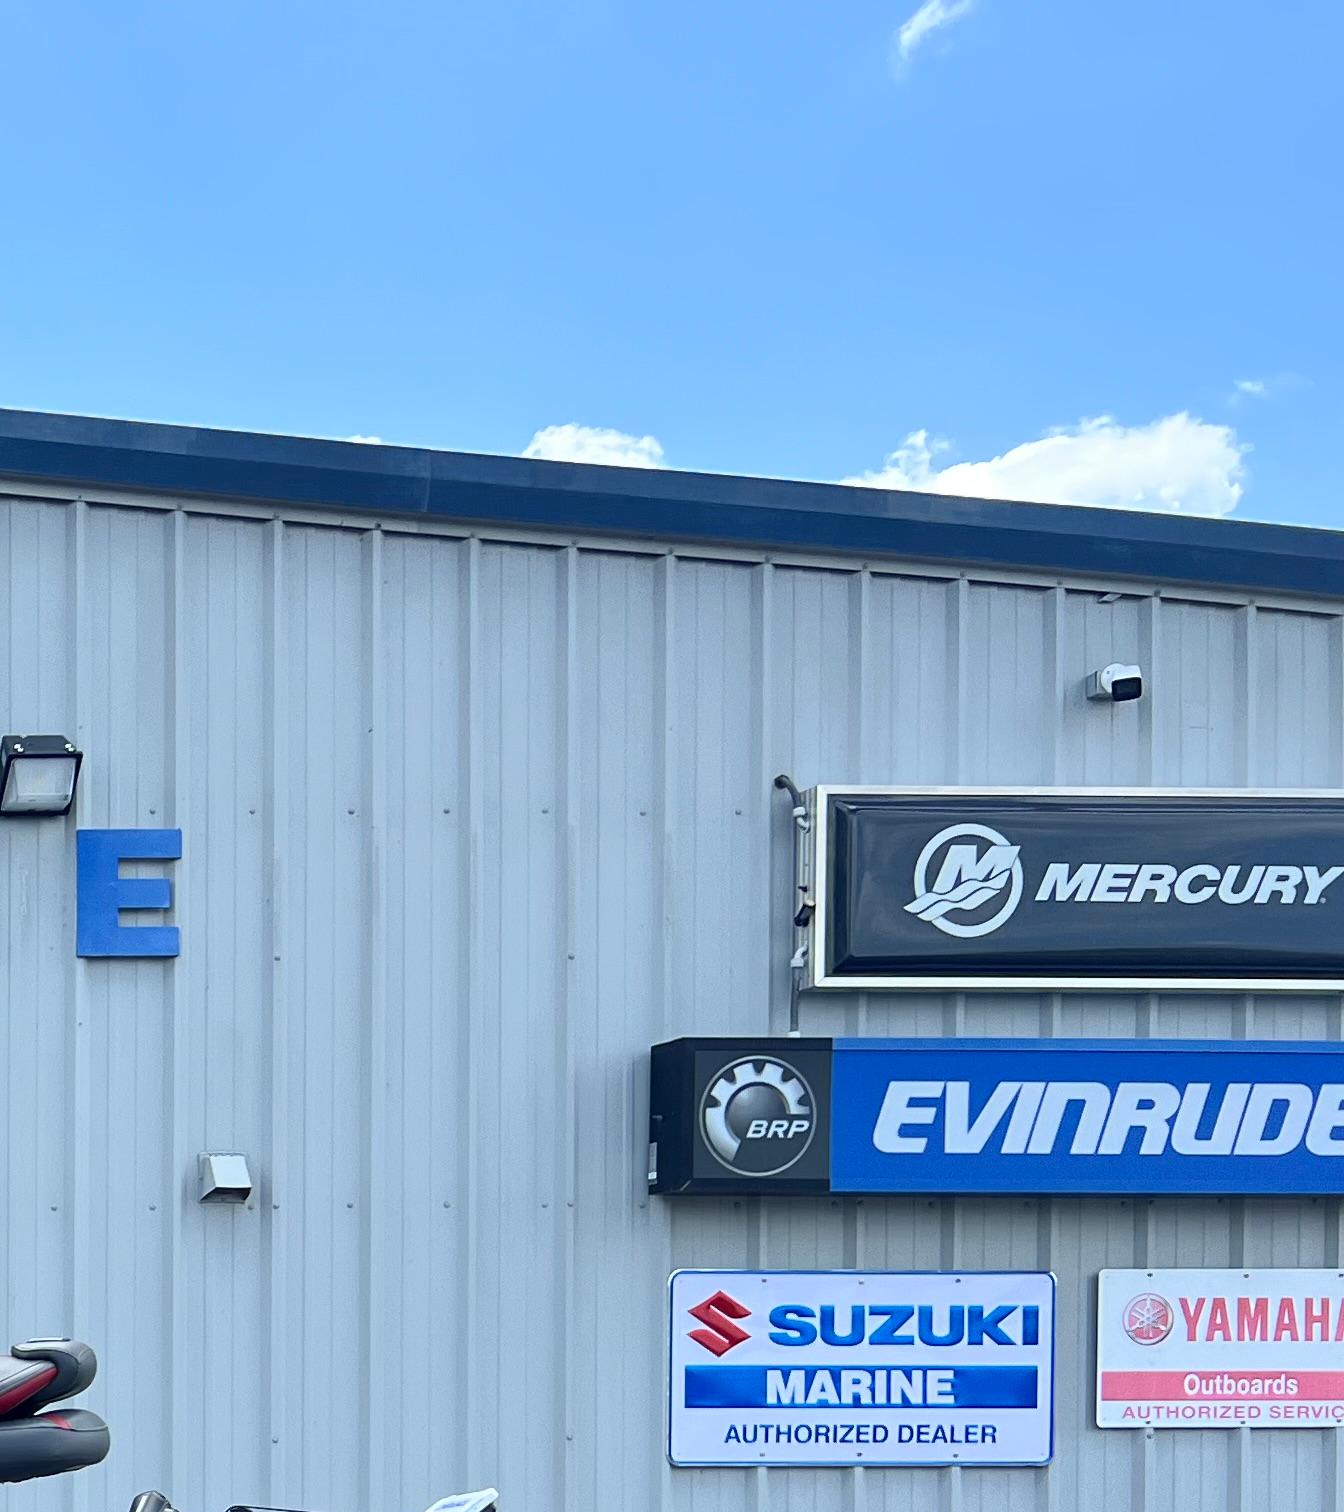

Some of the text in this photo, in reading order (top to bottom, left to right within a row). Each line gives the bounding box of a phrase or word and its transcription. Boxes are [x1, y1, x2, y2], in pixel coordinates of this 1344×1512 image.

[1035, 863, 1344, 904] MERCURY
[746, 1119, 810, 1138] BRP
[768, 1304, 1039, 1346] SUZUKI
[766, 1369, 955, 1405] MARINE
[1183, 1373, 1298, 1395] Outboards
[1122, 1406, 1261, 1419] AUTHORIZED
[724, 1424, 997, 1444] AUTHORIZED DEALER
